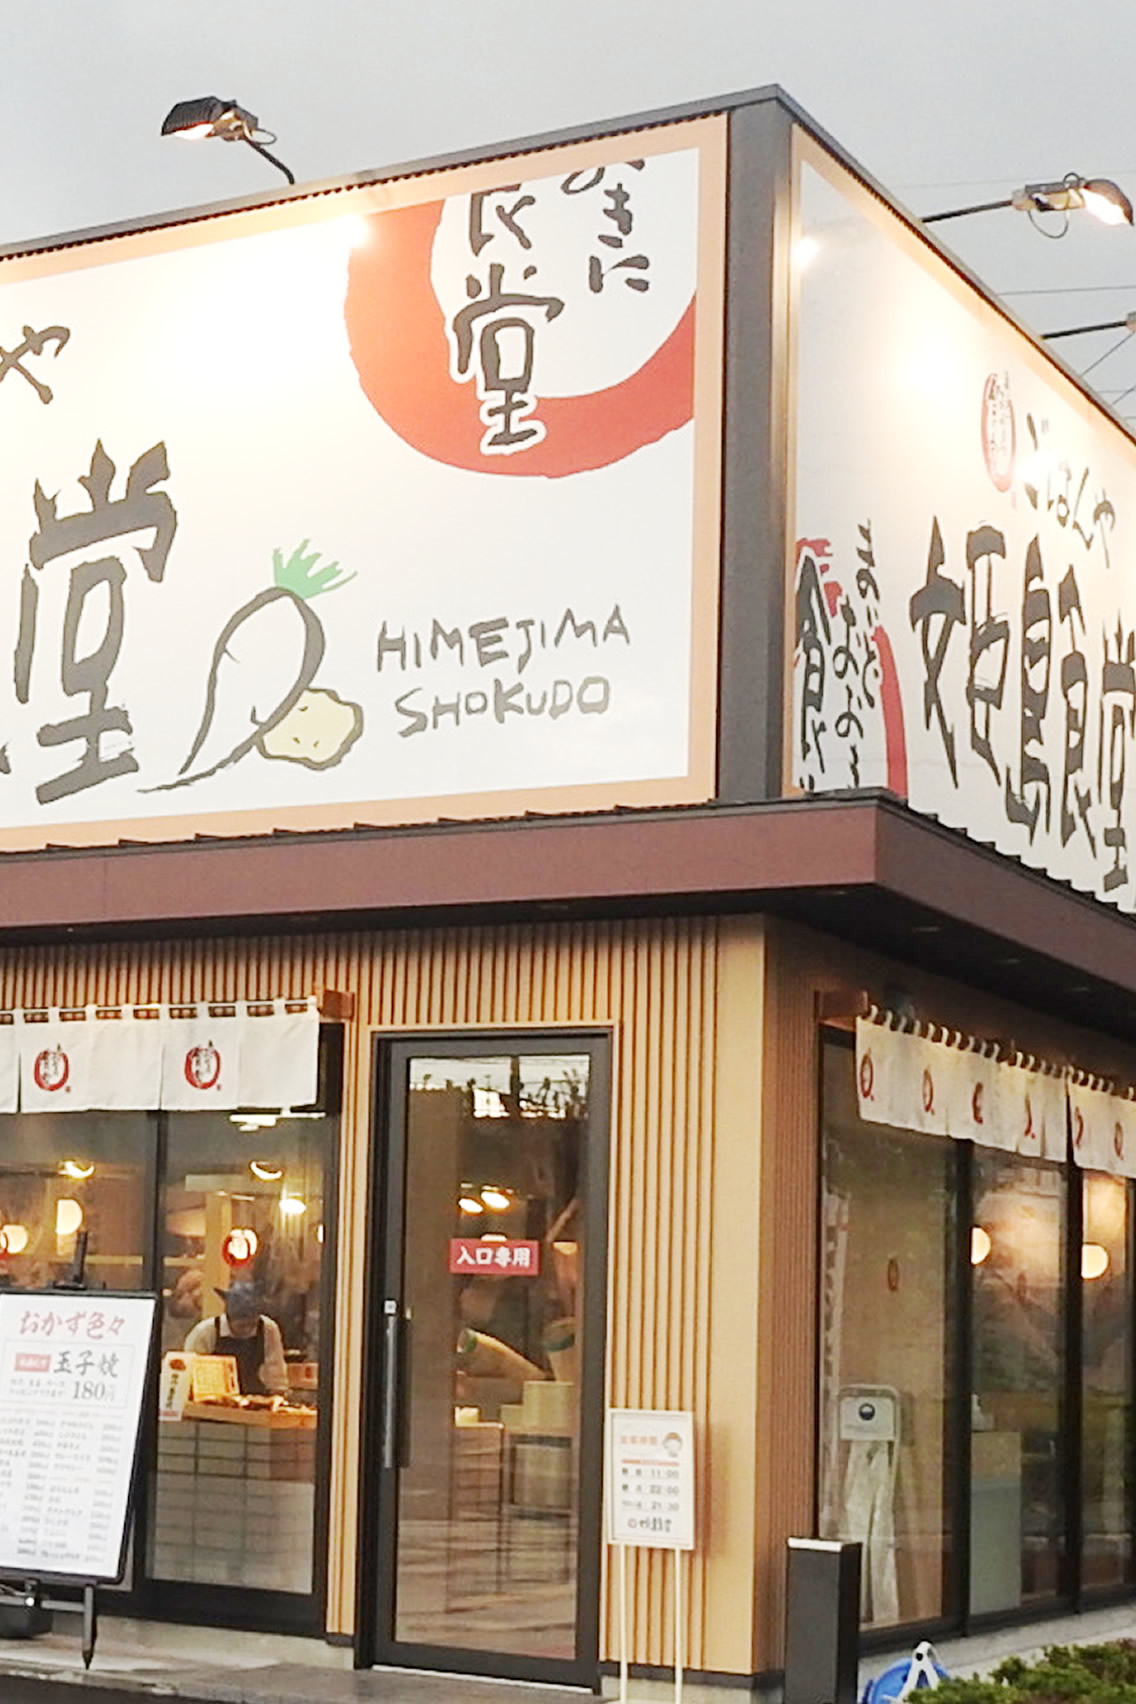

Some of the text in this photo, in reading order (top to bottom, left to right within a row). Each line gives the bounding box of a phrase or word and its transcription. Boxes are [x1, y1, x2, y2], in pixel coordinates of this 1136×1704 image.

[376, 604, 631, 672] HIMEJIMA
[795, 554, 831, 790] 食
[395, 676, 611, 737] SHOKUDO
[456, 1246, 531, 1268] 入口専用
[20, 1311, 125, 1339] おかず色々
[53, 1350, 118, 1378] 玉子焼
